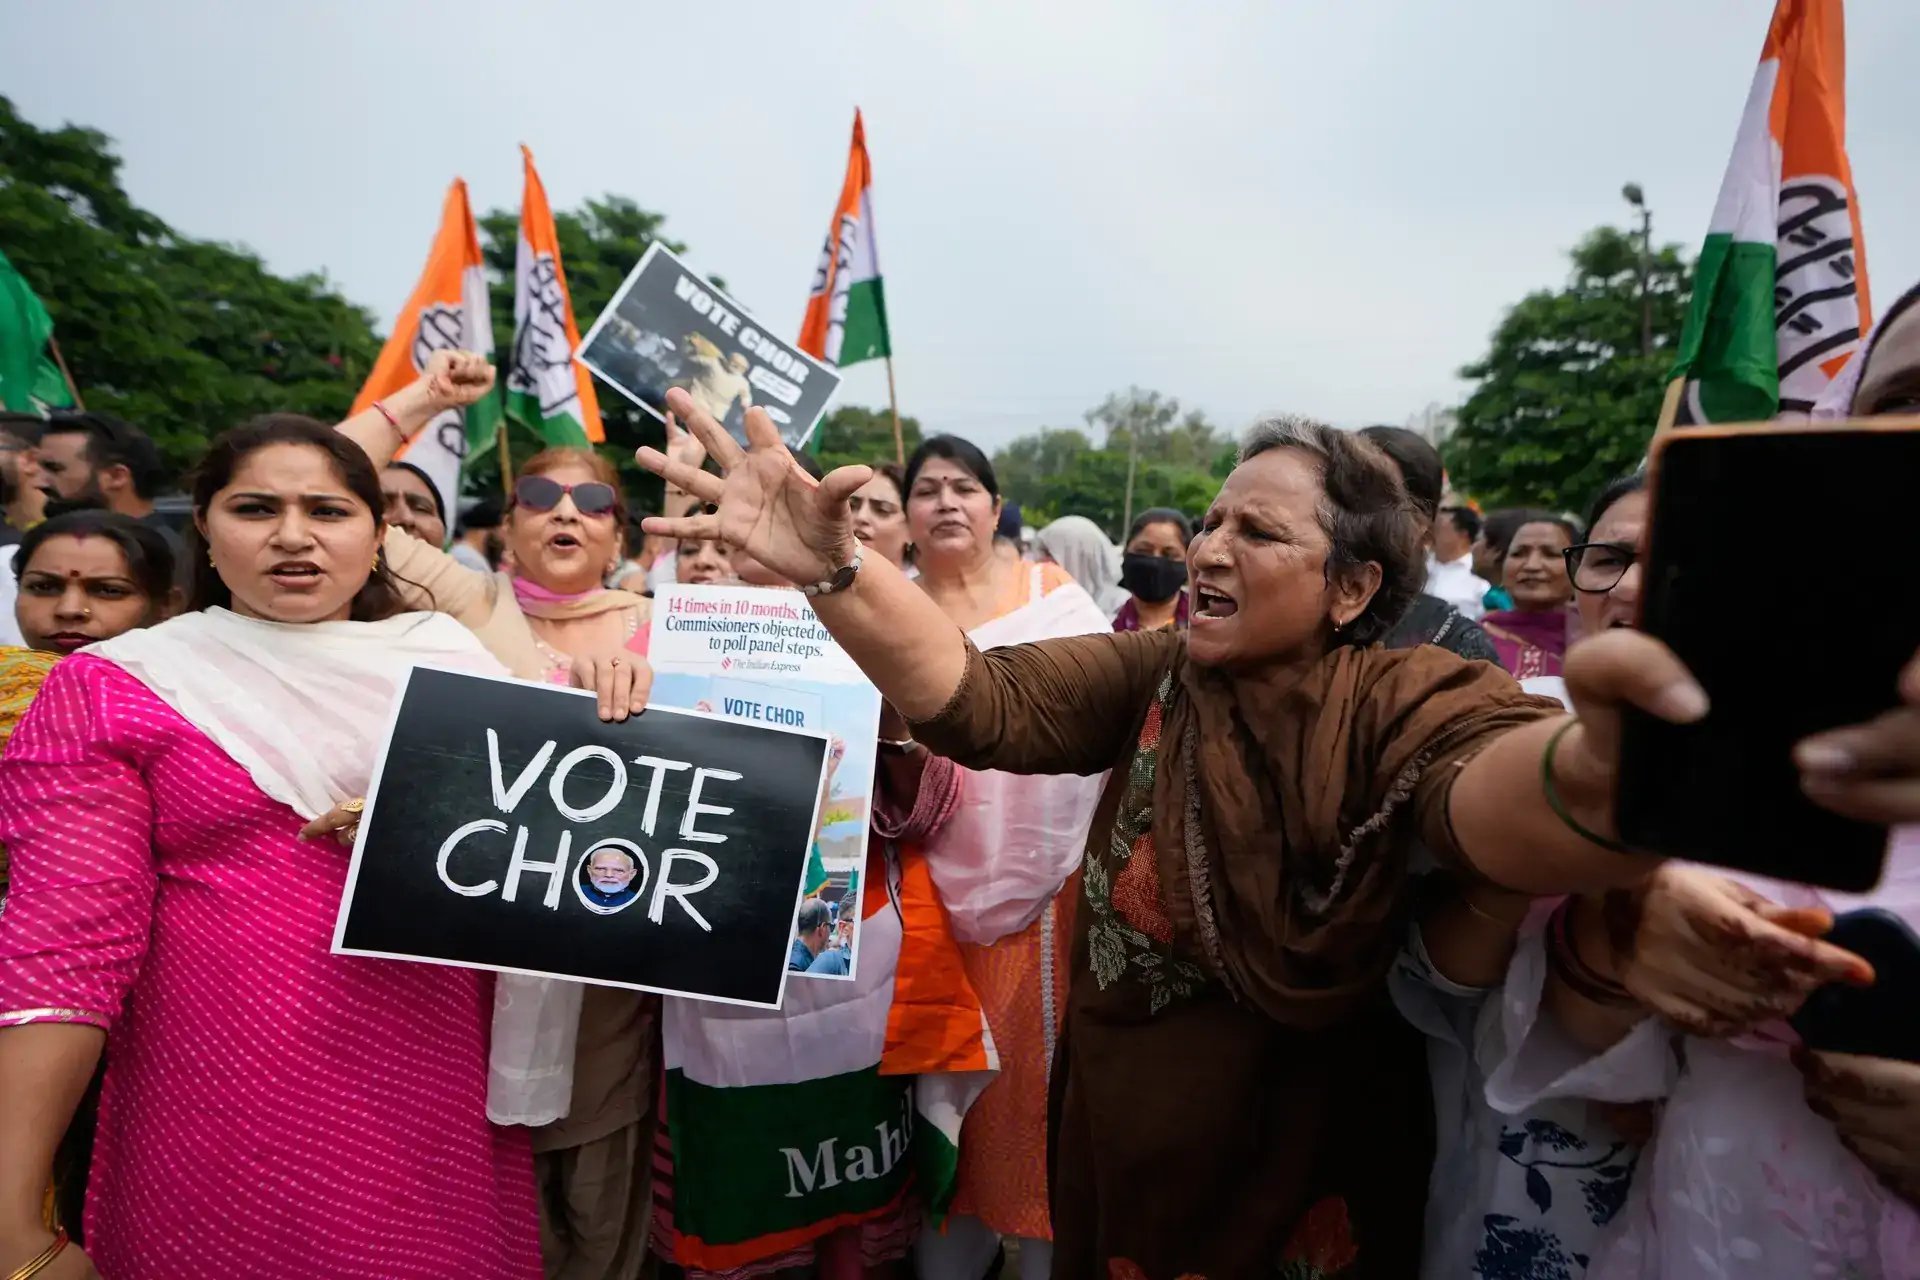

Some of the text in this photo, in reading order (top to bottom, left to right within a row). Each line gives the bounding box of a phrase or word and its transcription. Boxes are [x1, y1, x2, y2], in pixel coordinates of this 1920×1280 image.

[674, 274, 810, 384] VOTE CHOR
[669, 597, 819, 620] 14 times in 10 months, tw
[666, 615, 760, 633] Commissioners
[762, 620, 815, 639] objected
[709, 635, 824, 659] to poll panel steps.
[770, 660, 801, 672] Express
[724, 697, 804, 727] VOTE CHOR
[486, 728, 744, 844] VOTE
[436, 819, 720, 933] CHOR
